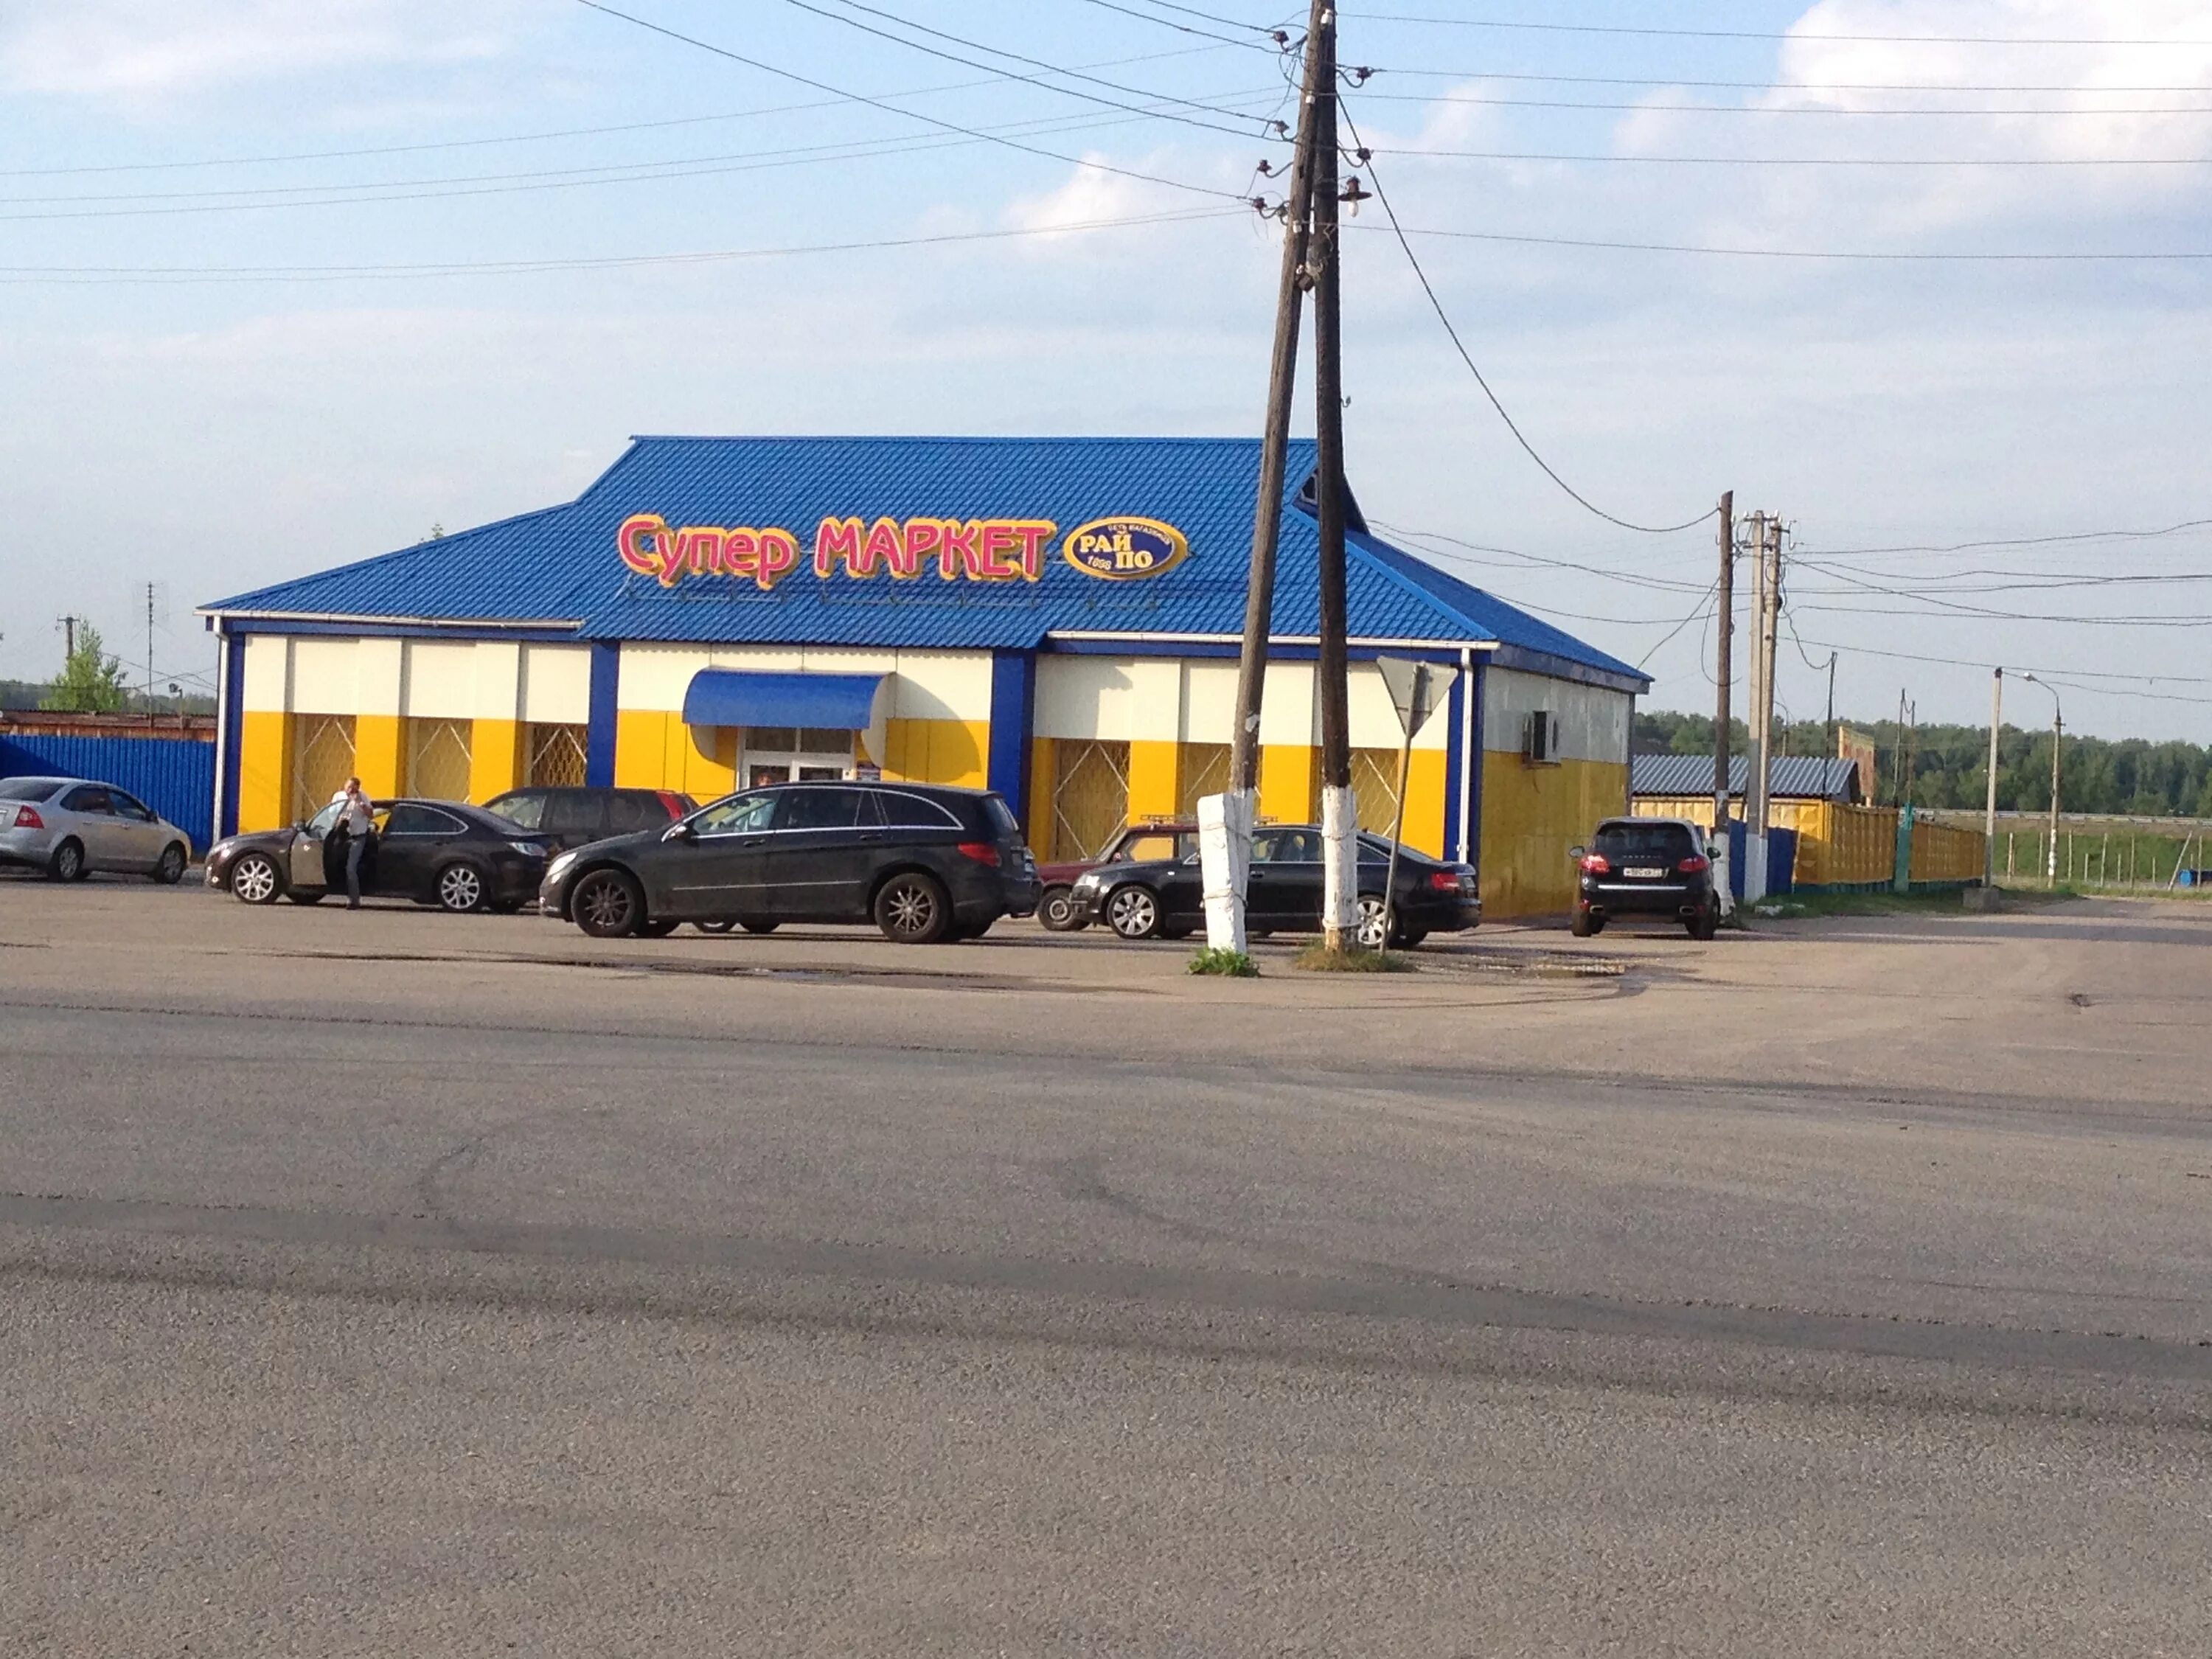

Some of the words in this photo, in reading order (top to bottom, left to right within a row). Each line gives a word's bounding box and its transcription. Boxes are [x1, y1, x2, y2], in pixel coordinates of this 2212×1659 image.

[619, 515, 799, 589] Супер
[815, 517, 1056, 582] МАРКЕТ
[1079, 530, 1132, 552] РАЙ
[1115, 550, 1153, 568] ПО
